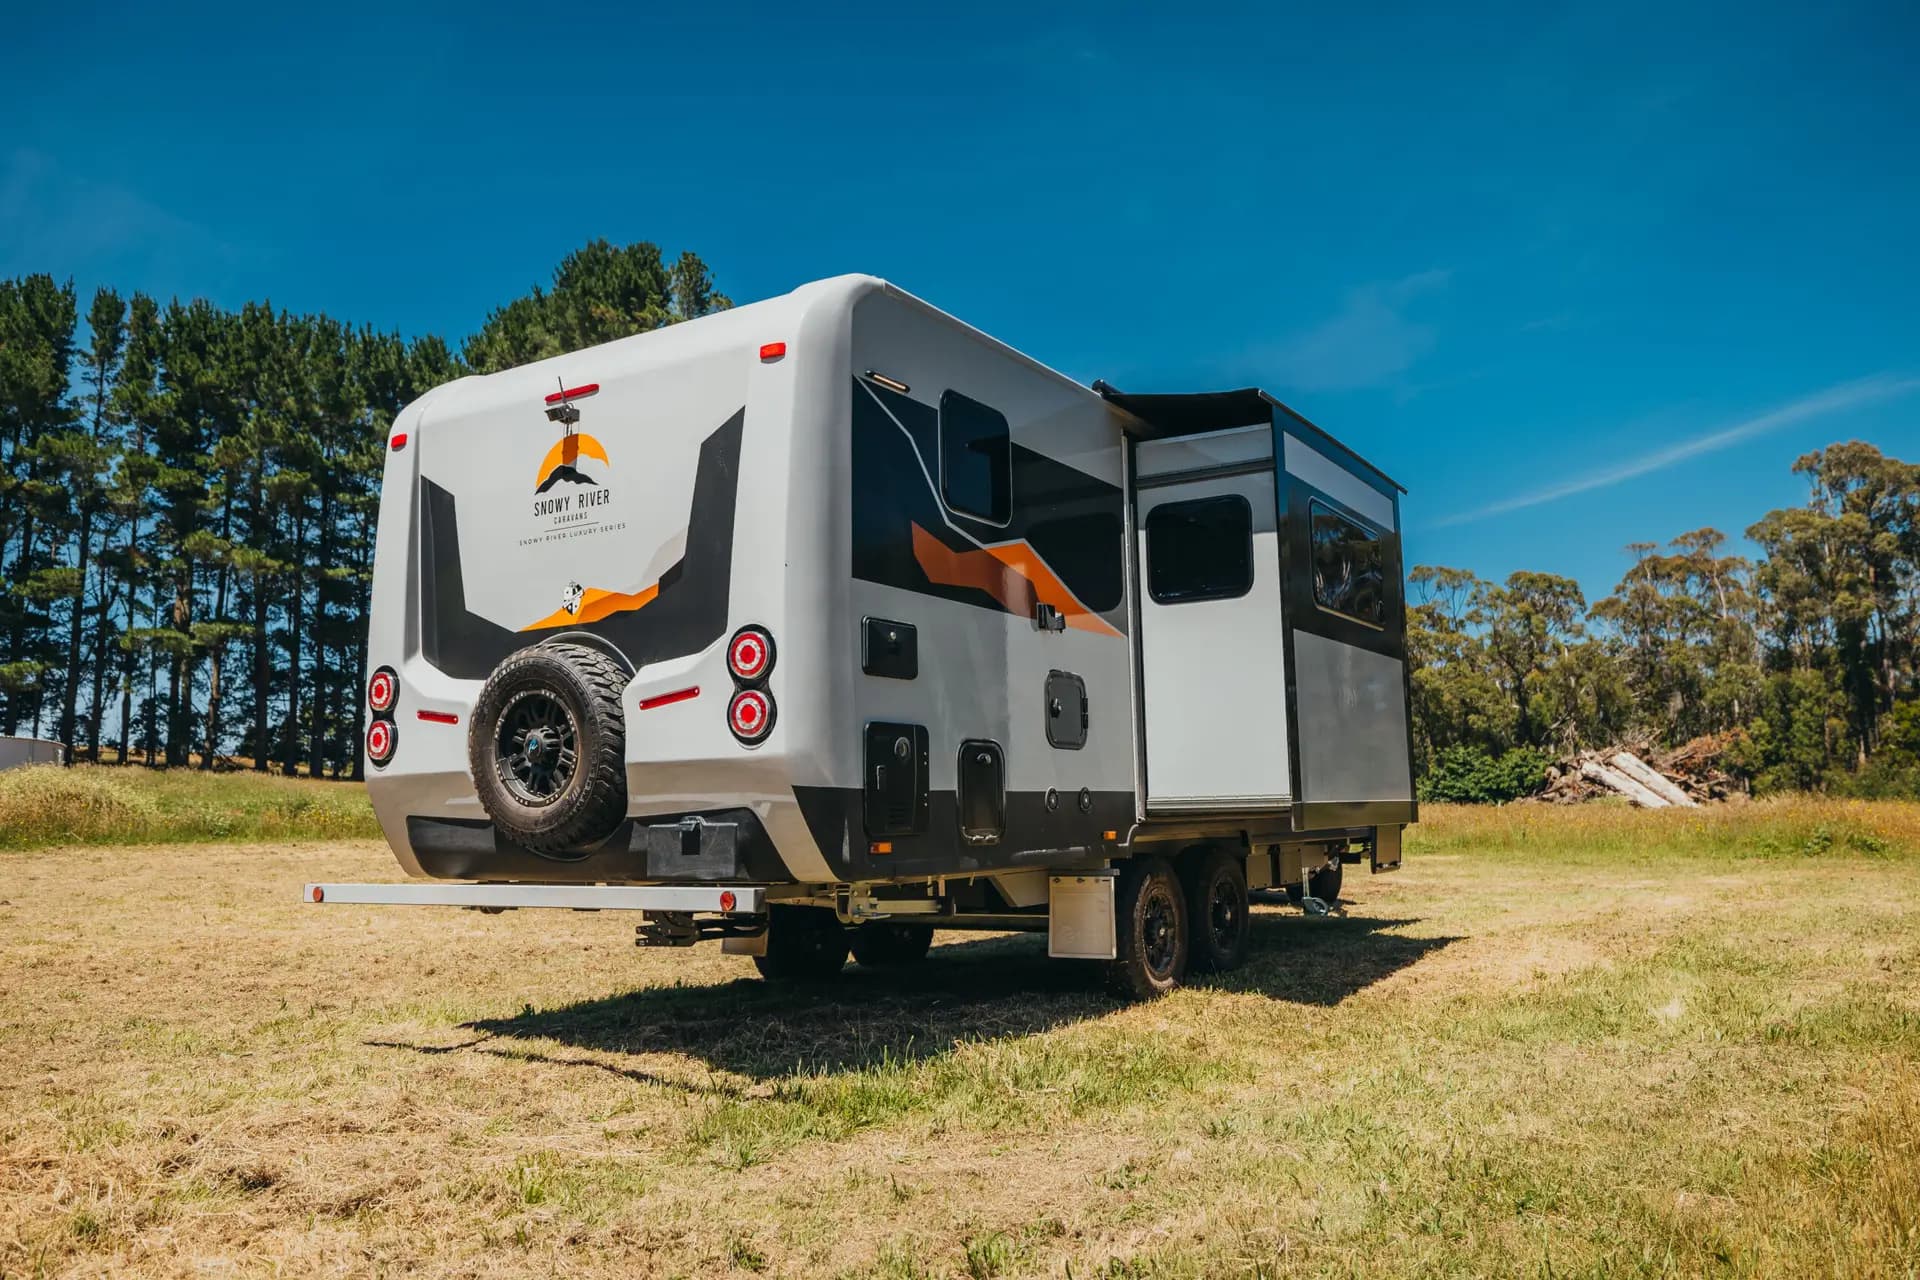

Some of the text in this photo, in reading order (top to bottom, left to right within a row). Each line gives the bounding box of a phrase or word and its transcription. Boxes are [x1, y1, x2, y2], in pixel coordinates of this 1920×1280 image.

[534, 489, 610, 517] SNOWY RIVER
[553, 512, 588, 525] CARAVANS
[569, 528, 598, 538] LUXURY
[600, 522, 627, 533] SERIES
